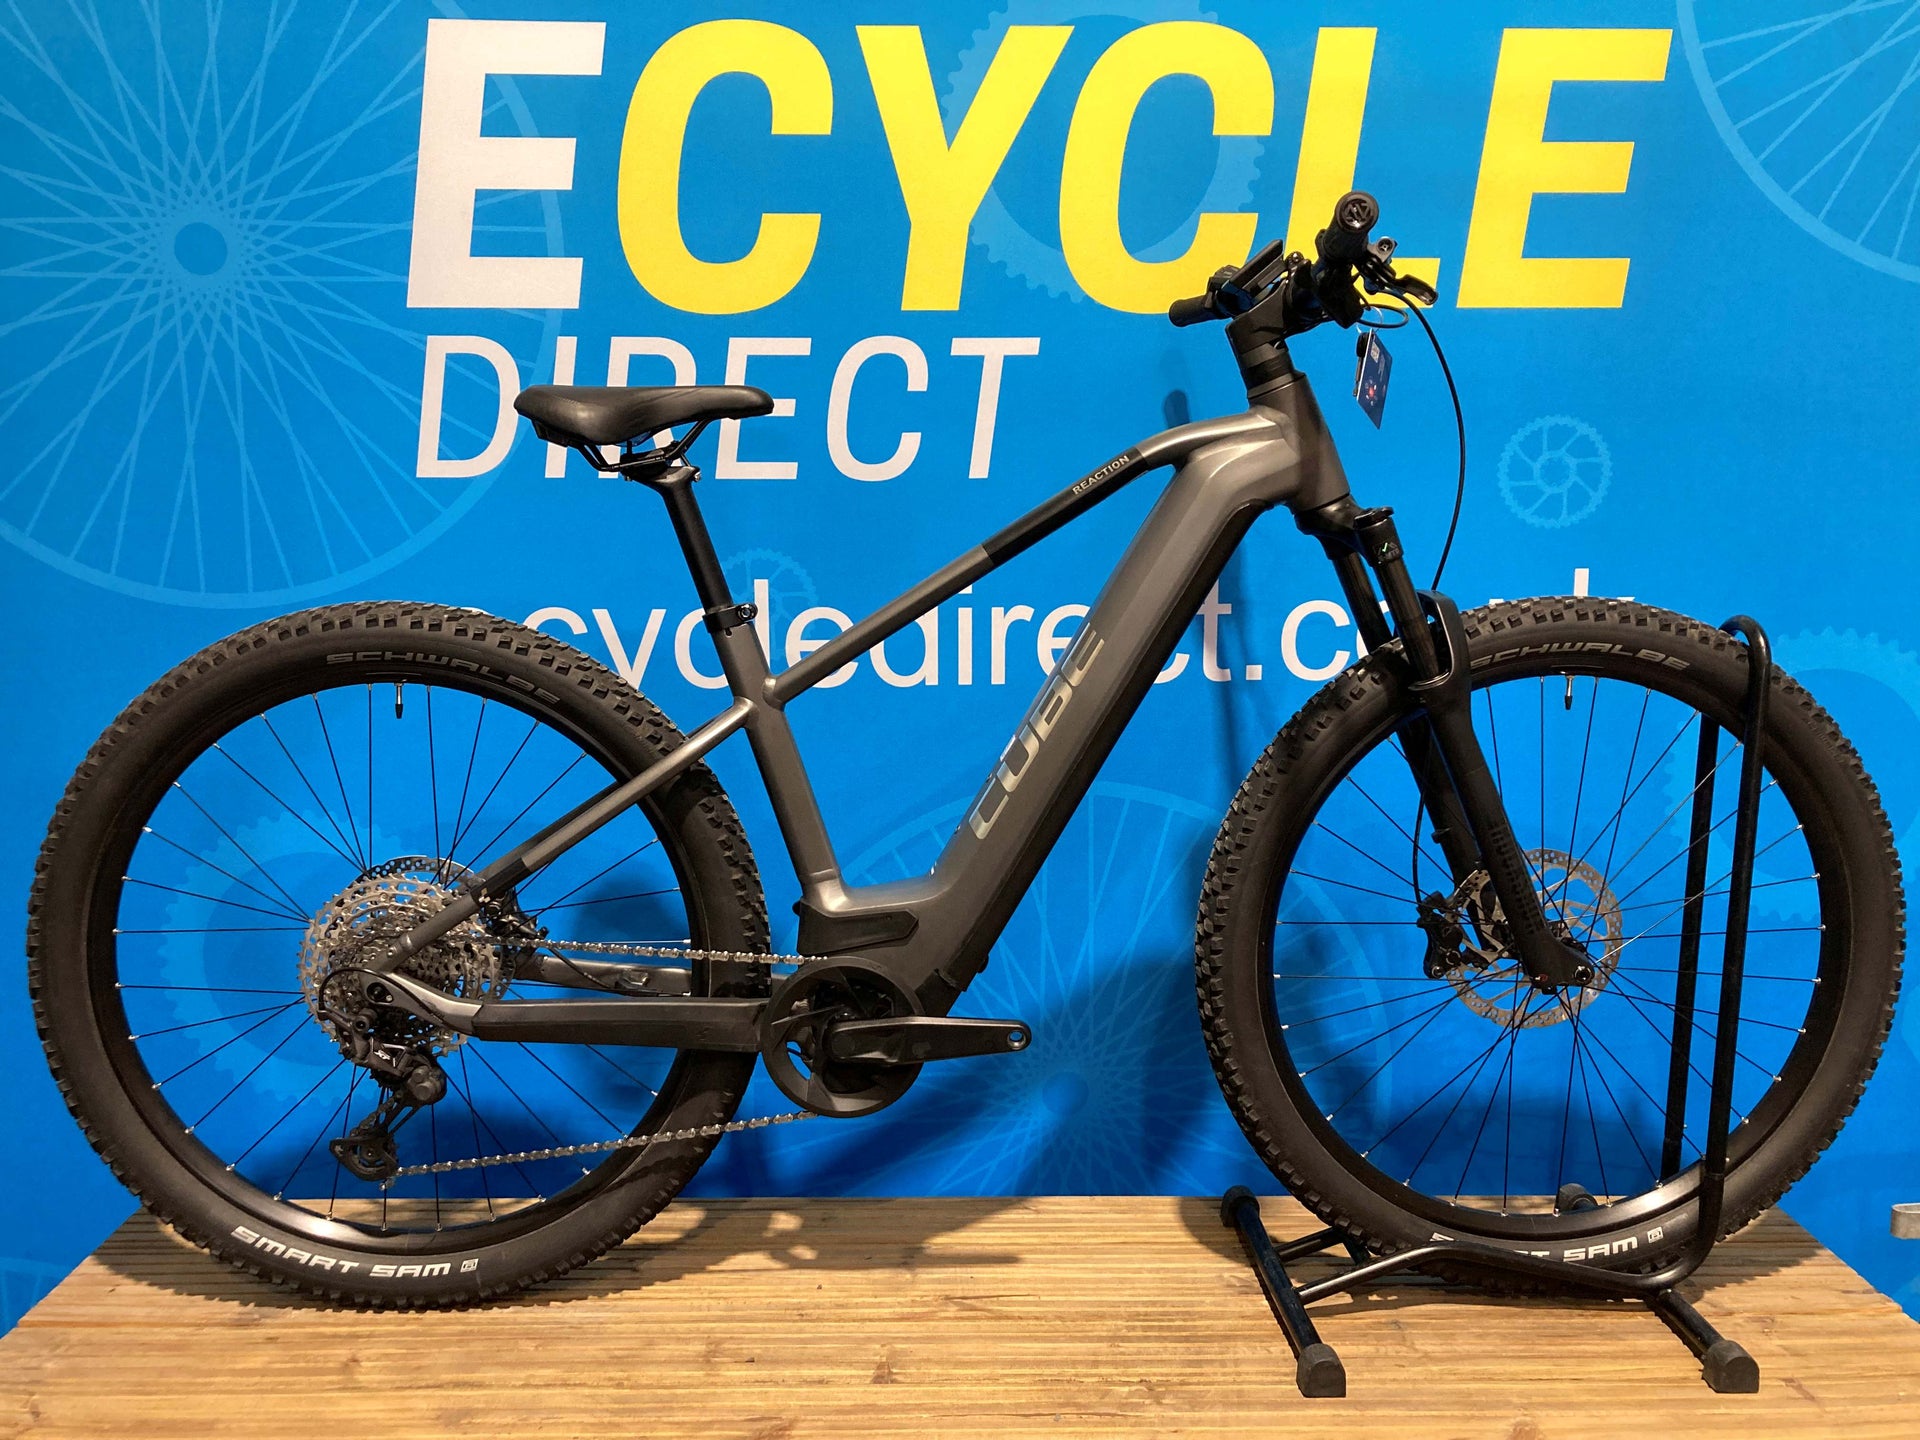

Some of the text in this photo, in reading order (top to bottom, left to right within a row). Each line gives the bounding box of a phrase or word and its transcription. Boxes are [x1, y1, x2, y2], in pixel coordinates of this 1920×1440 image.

[406, 18, 1673, 315] ECYCLE
[415, 335, 1041, 481] DIRECT
[1072, 455, 1130, 495] REACTION
[326, 651, 561, 705] SCHWALBE
[1469, 641, 1692, 671] SCHWALBE
[968, 622, 1105, 840] CUBE
[230, 1225, 452, 1278] SMART SAM
[1562, 1235, 1639, 1263] SAM
